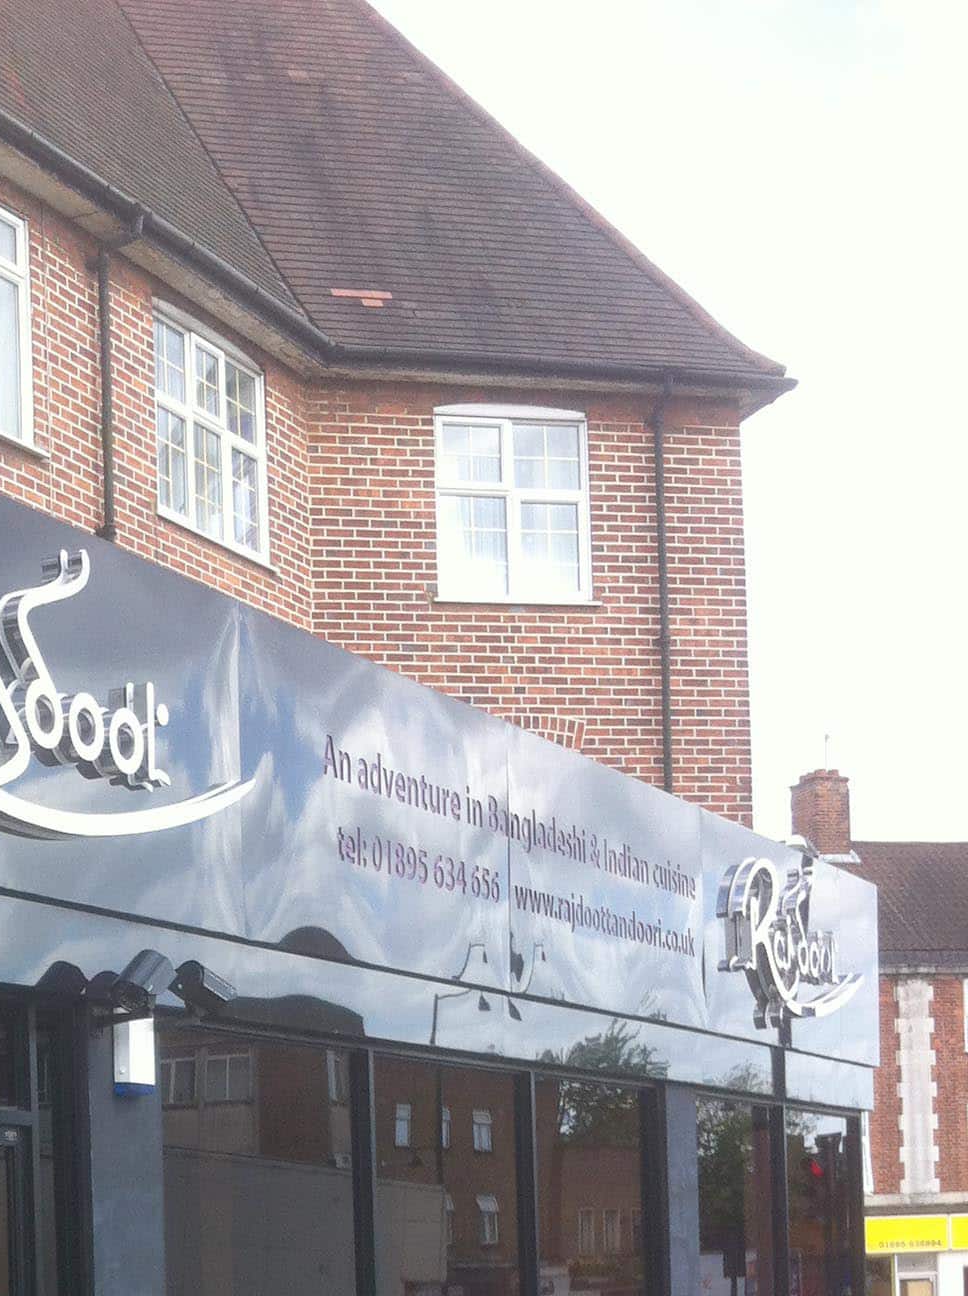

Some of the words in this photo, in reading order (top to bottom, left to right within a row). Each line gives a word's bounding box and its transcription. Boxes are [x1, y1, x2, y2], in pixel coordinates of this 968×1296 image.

[324, 734, 352, 784] An
[358, 752, 461, 821] adventure
[466, 785, 483, 828] in
[488, 795, 586, 864] Bangladeshi
[590, 833, 601, 869] &
[603, 838, 650, 885] Indian
[653, 860, 696, 900] cuisine
[337, 826, 368, 868] tel:
[372, 835, 429, 885] 01895
[434, 855, 468, 895] 634
[471, 864, 500, 903] 656
[514, 884, 696, 958] www.rajdoottandoori.co.uk
